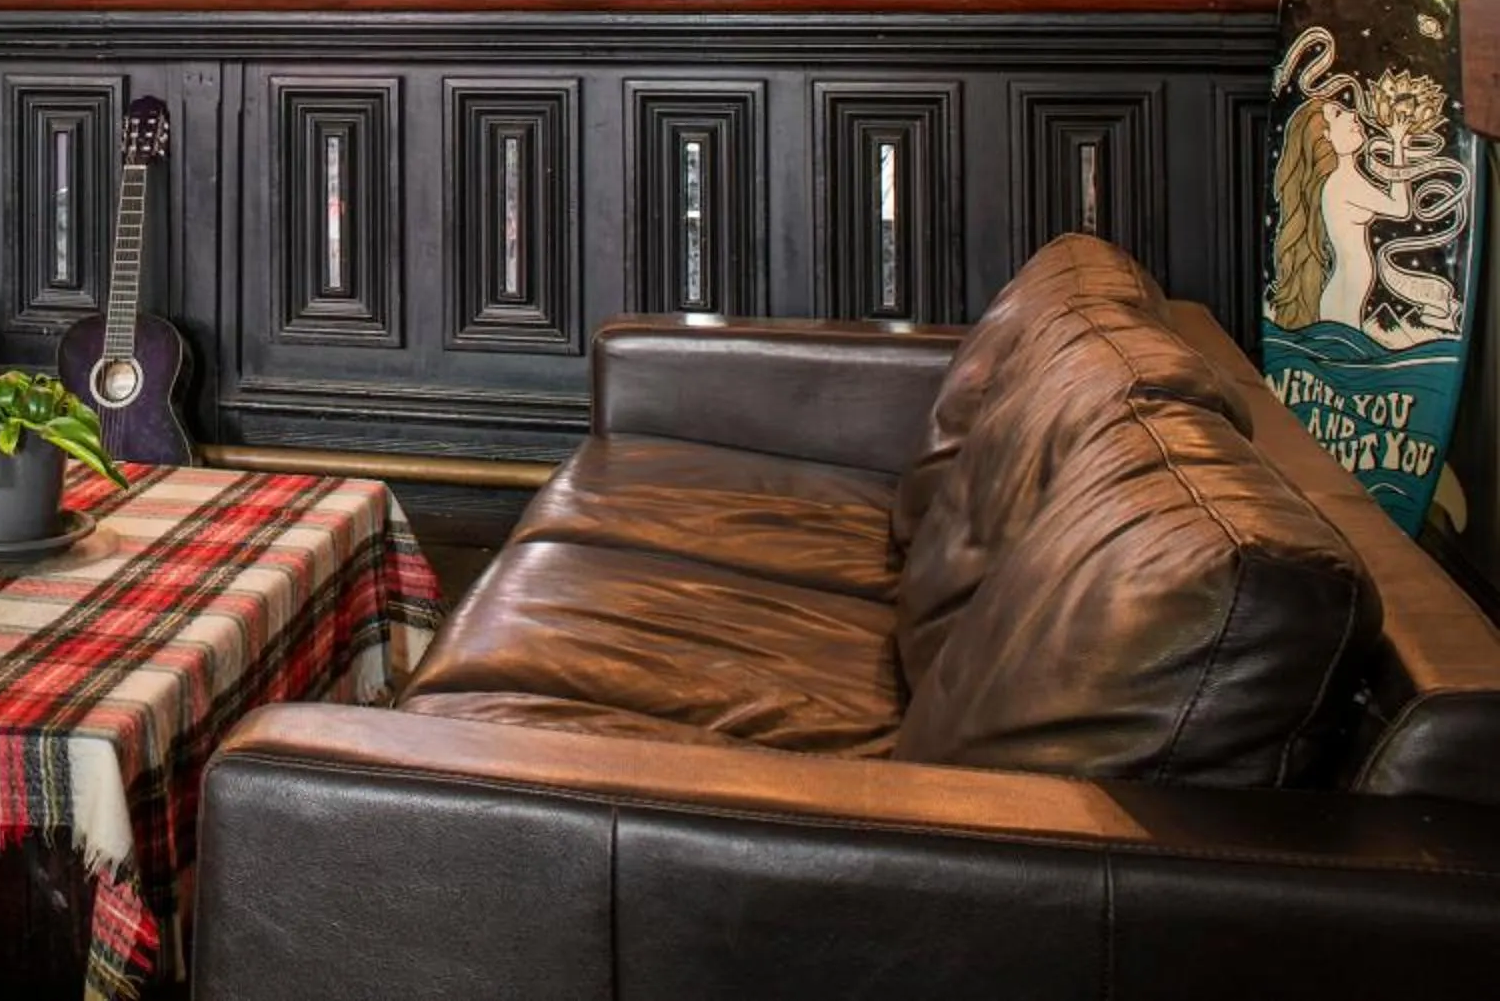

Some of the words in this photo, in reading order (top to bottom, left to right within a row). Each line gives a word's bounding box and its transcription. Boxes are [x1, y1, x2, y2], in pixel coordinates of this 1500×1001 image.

[1308, 407, 1355, 440] AND
[1352, 392, 1414, 429] YOU
[1382, 430, 1435, 476] YOU
